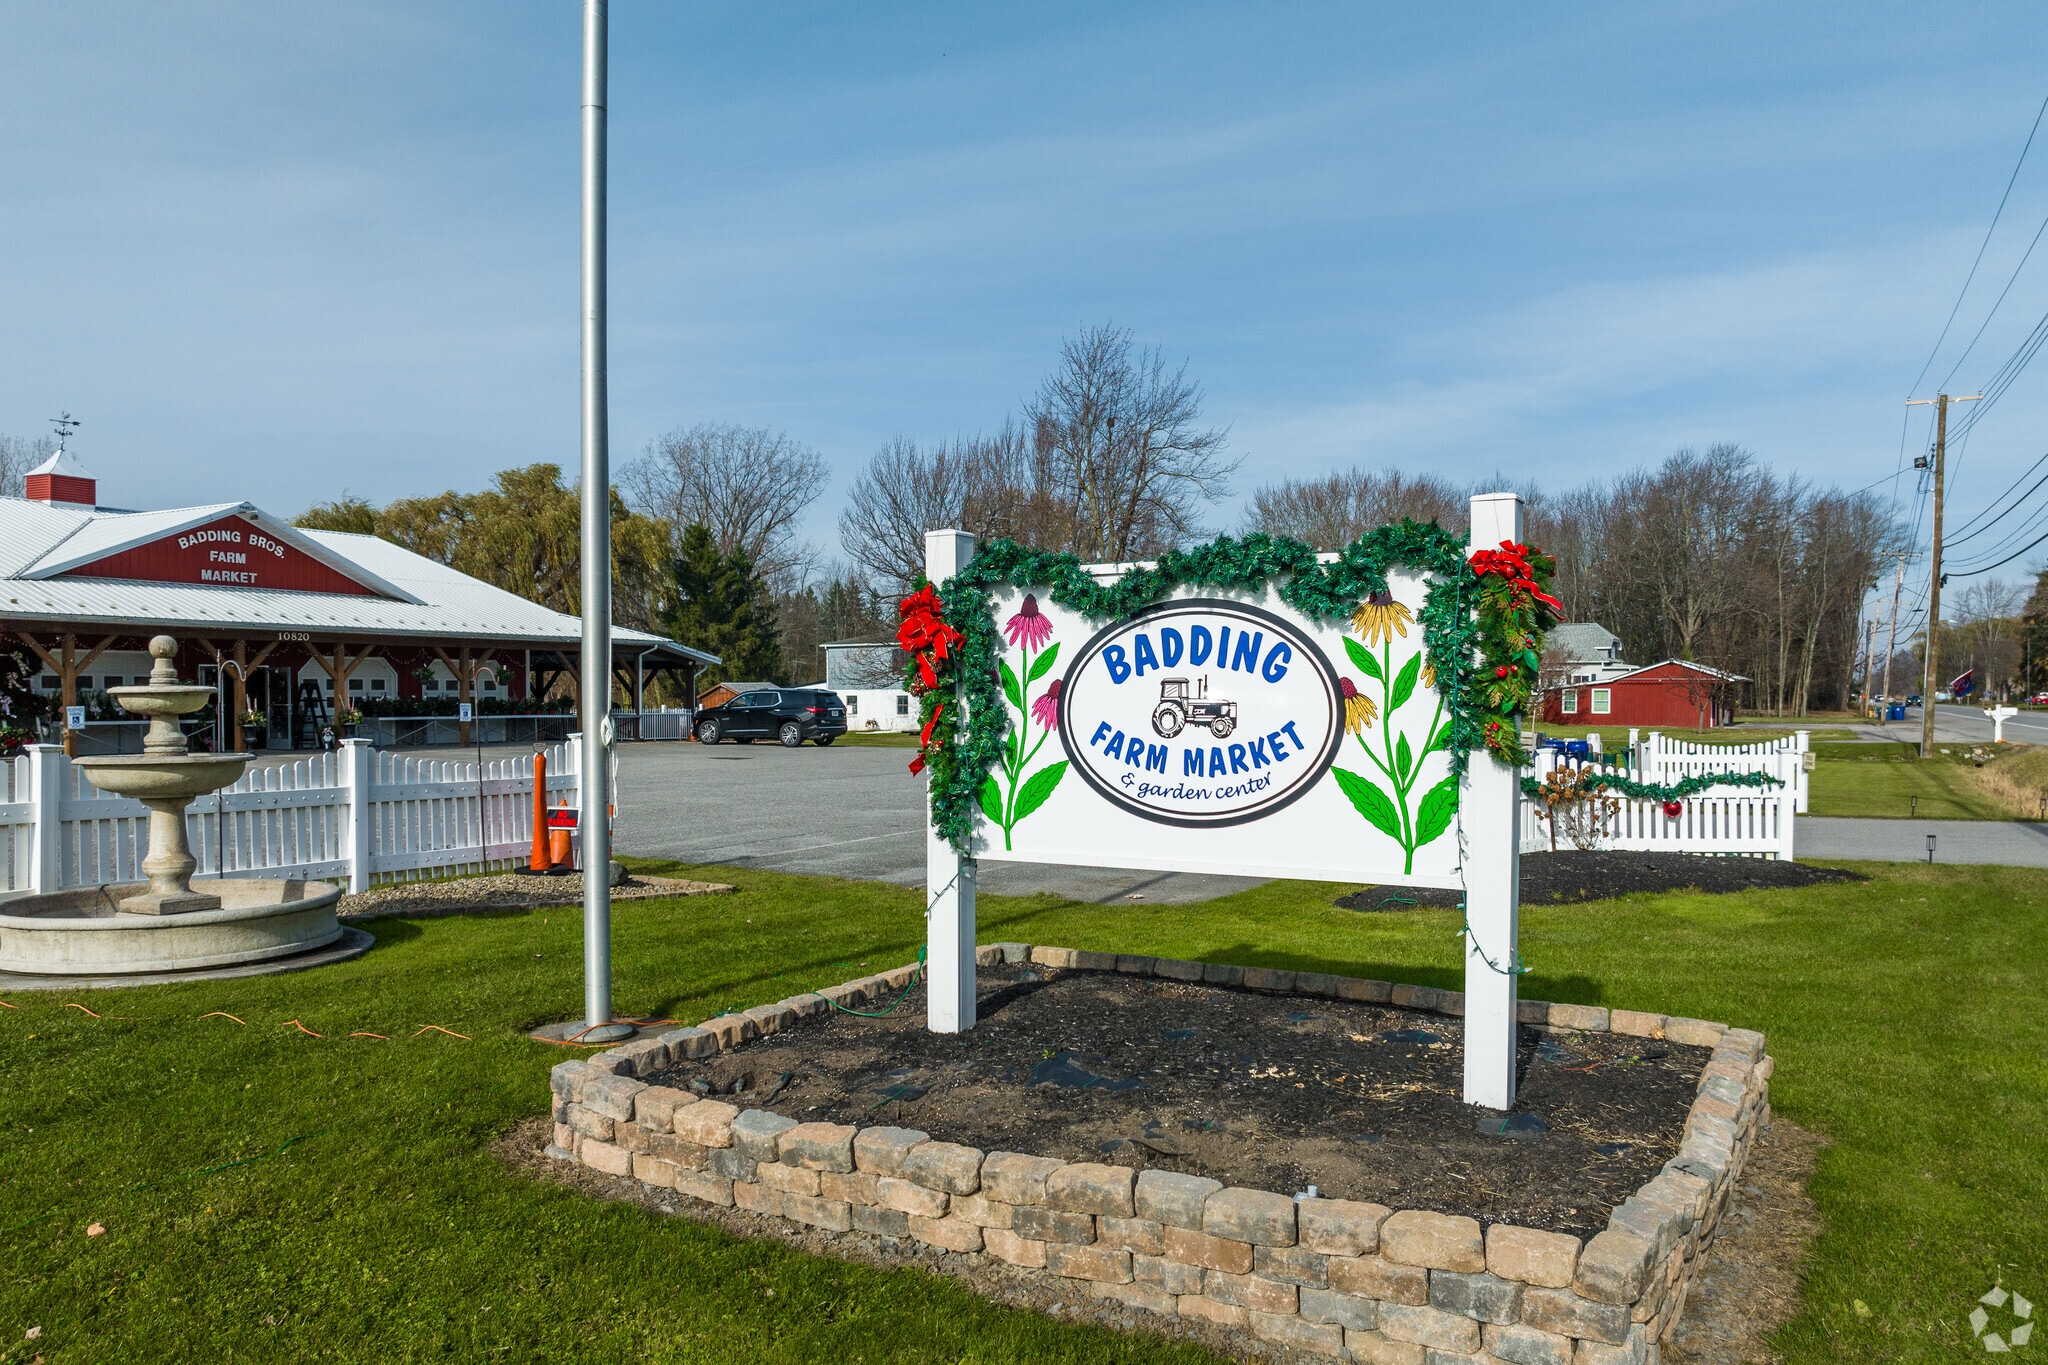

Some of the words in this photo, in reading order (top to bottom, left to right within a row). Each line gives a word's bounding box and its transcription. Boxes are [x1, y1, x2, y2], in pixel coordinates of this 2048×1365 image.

[178, 530, 241, 550] BADDING
[249, 534, 285, 559] BROS.
[210, 550, 246, 564] FARM
[201, 569, 258, 584] MARKET
[278, 632, 310, 641] 10820
[1102, 624, 1292, 684] BADDING
[1089, 720, 1168, 775] FARM
[1184, 720, 1305, 778] MARKET
[1120, 772, 1135, 789] &
[1137, 782, 1213, 800] garden
[1215, 772, 1272, 799] center
[557, 810, 569, 819] NO
[547, 818, 577, 827] PARKING
